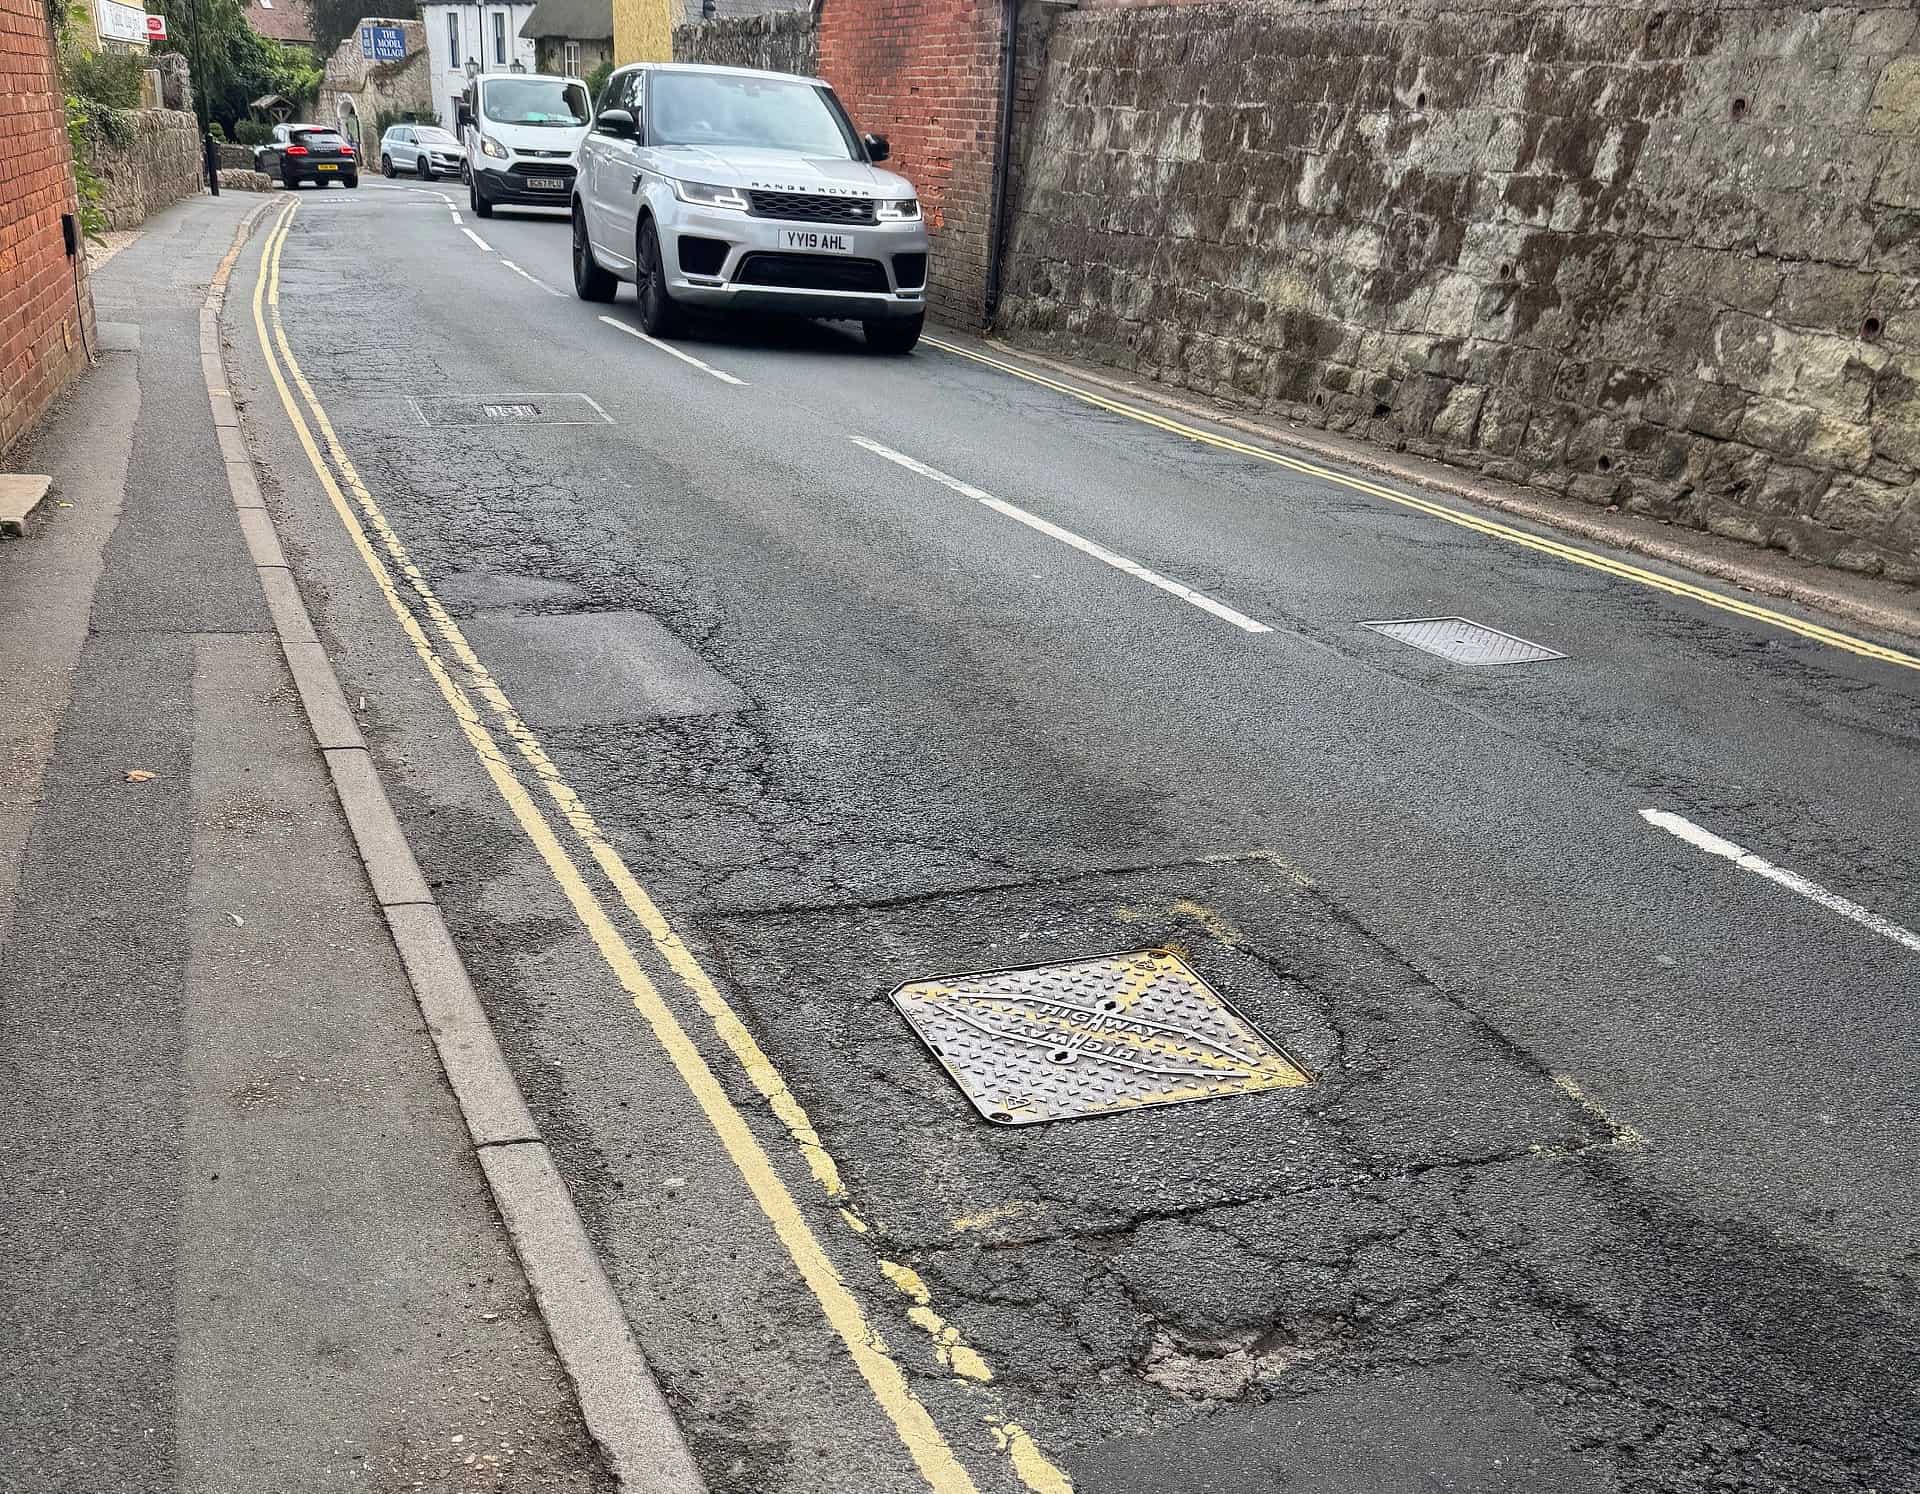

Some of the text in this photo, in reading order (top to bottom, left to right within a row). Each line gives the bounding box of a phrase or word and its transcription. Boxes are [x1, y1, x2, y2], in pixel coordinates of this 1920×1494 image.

[382, 30, 397, 39] THE
[377, 39, 402, 48] MODEL
[376, 48, 404, 58] VILLAGE
[751, 182, 869, 196] RANGE ROVER
[787, 231, 847, 250] YY19 AHL
[1039, 1003, 1161, 1038] HIGHWAY
[1010, 1028, 1137, 1061] HIGHWAY
